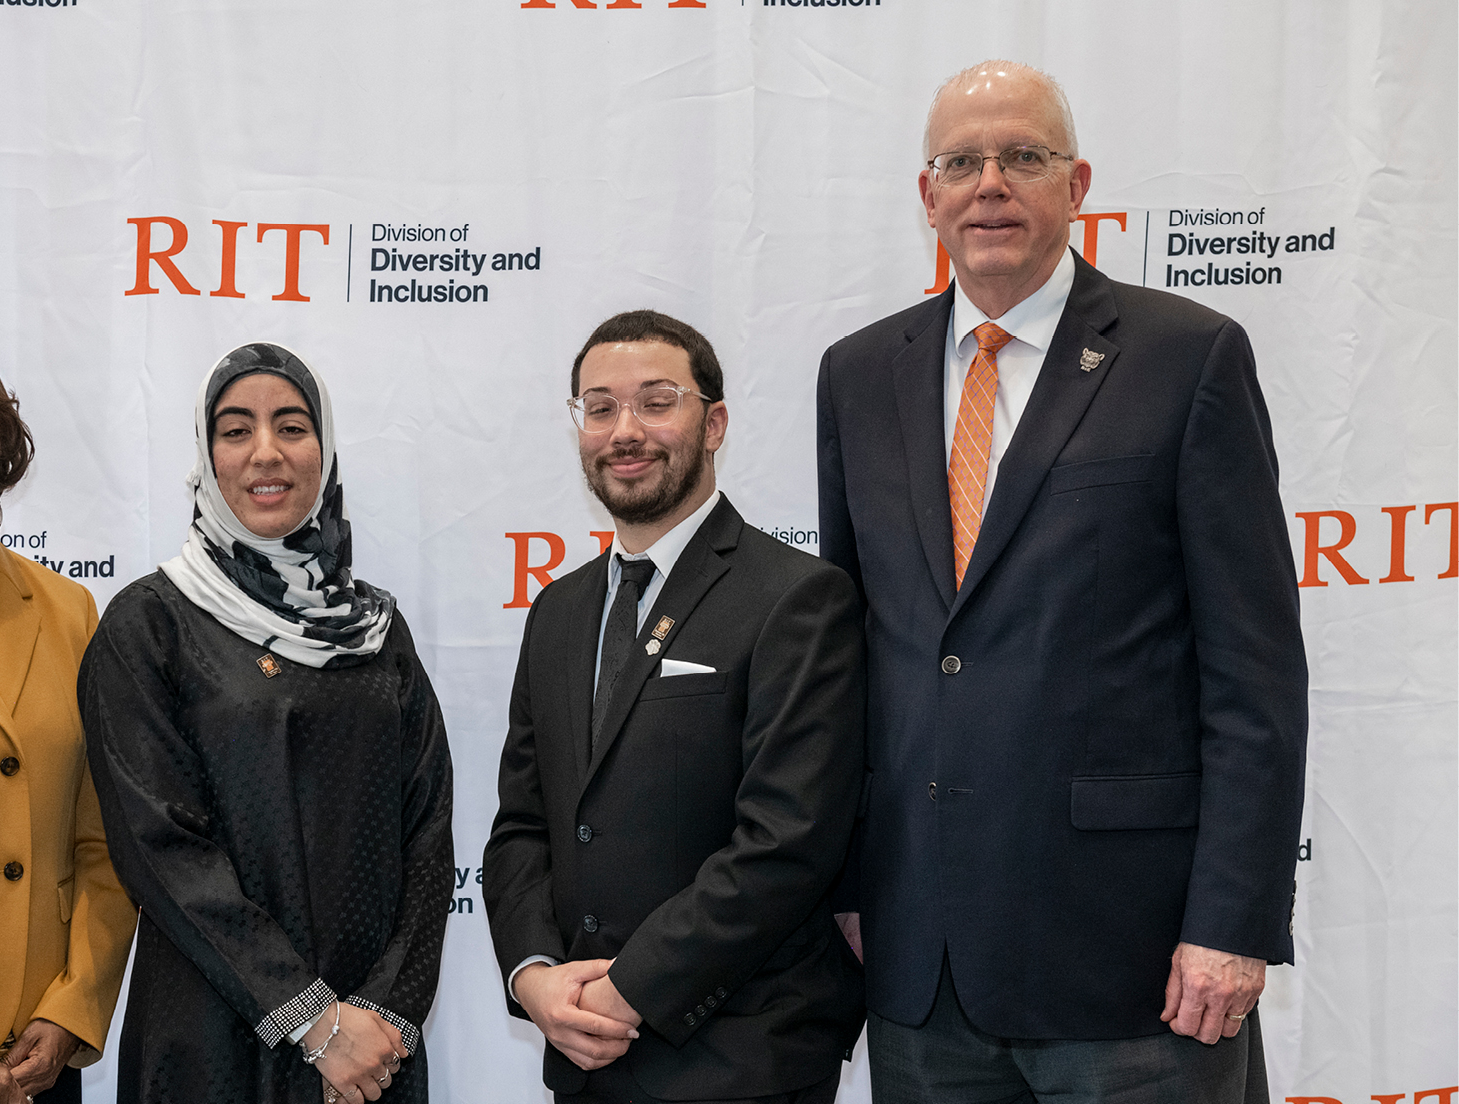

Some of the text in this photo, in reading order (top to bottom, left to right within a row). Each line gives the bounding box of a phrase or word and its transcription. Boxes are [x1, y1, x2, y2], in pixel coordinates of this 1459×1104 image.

[1168, 206, 1266, 227] Division of
[372, 223, 470, 242] Division of
[1167, 226, 1336, 259] Diversity and
[124, 215, 330, 303] RIT
[370, 246, 541, 277] Diversity and
[1165, 261, 1282, 288] Inclusion
[369, 278, 489, 303] Inclusion
[28, 530, 47, 549] of
[760, 526, 818, 545] ision
[68, 554, 115, 578] and
